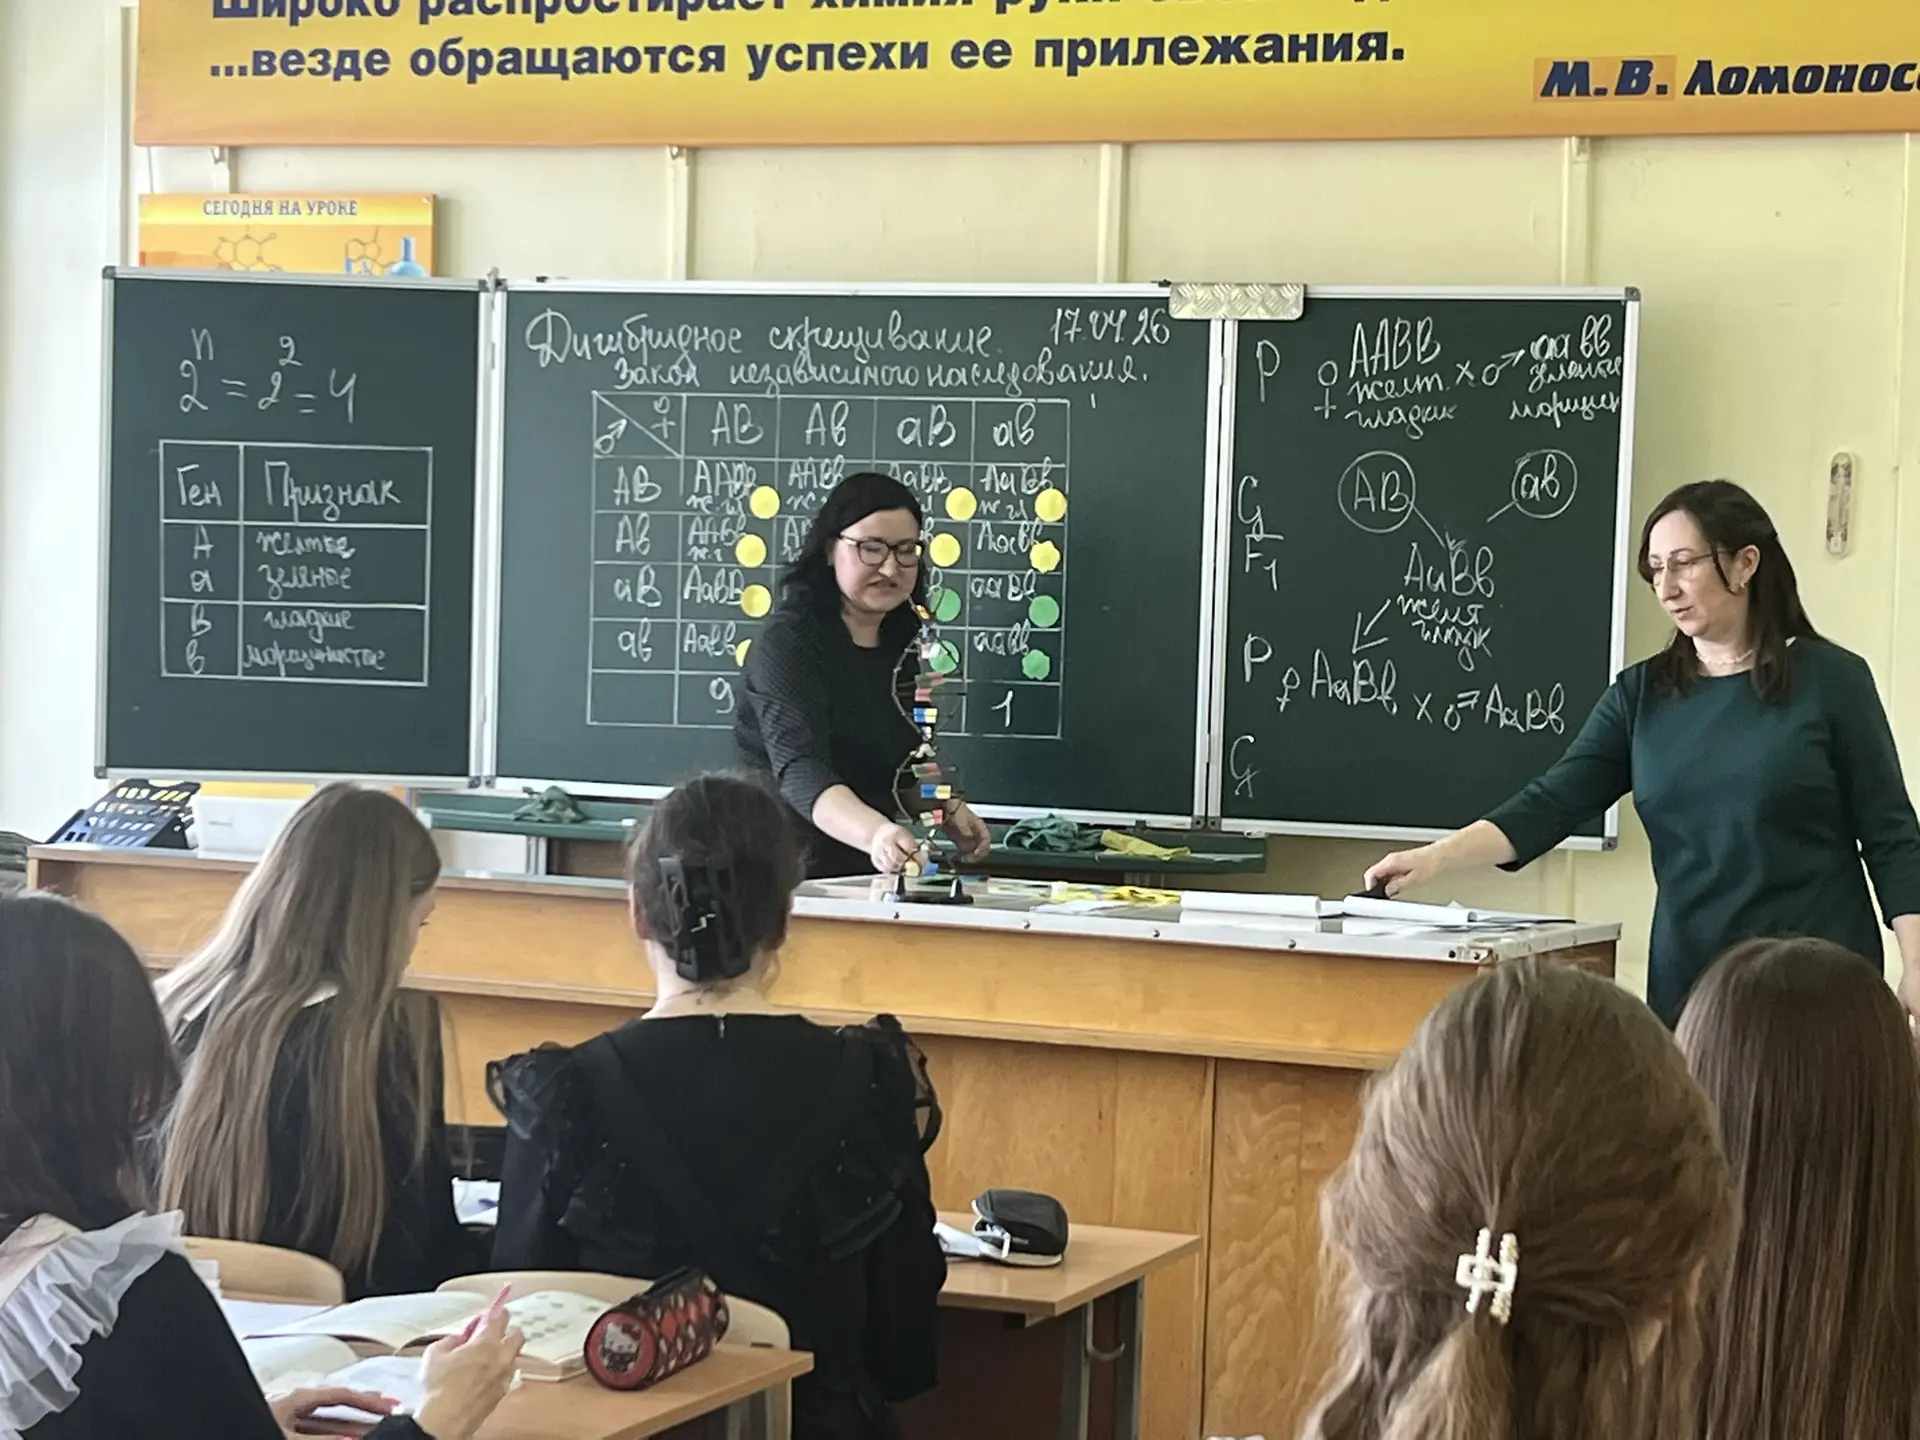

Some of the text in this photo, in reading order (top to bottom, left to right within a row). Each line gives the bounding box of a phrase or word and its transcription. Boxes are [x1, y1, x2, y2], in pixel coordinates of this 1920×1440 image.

[410, 36, 726, 84] обращаются
[746, 40, 929, 82] успехи
[950, 38, 1013, 69] ее
[1034, 31, 1405, 77] прилежания.
[1683, 60, 1920, 95] Ломонос
[202, 199, 358, 218] СЕГОДНЯ НА УРОКЕ
[176, 460, 401, 524] Ген Признак
